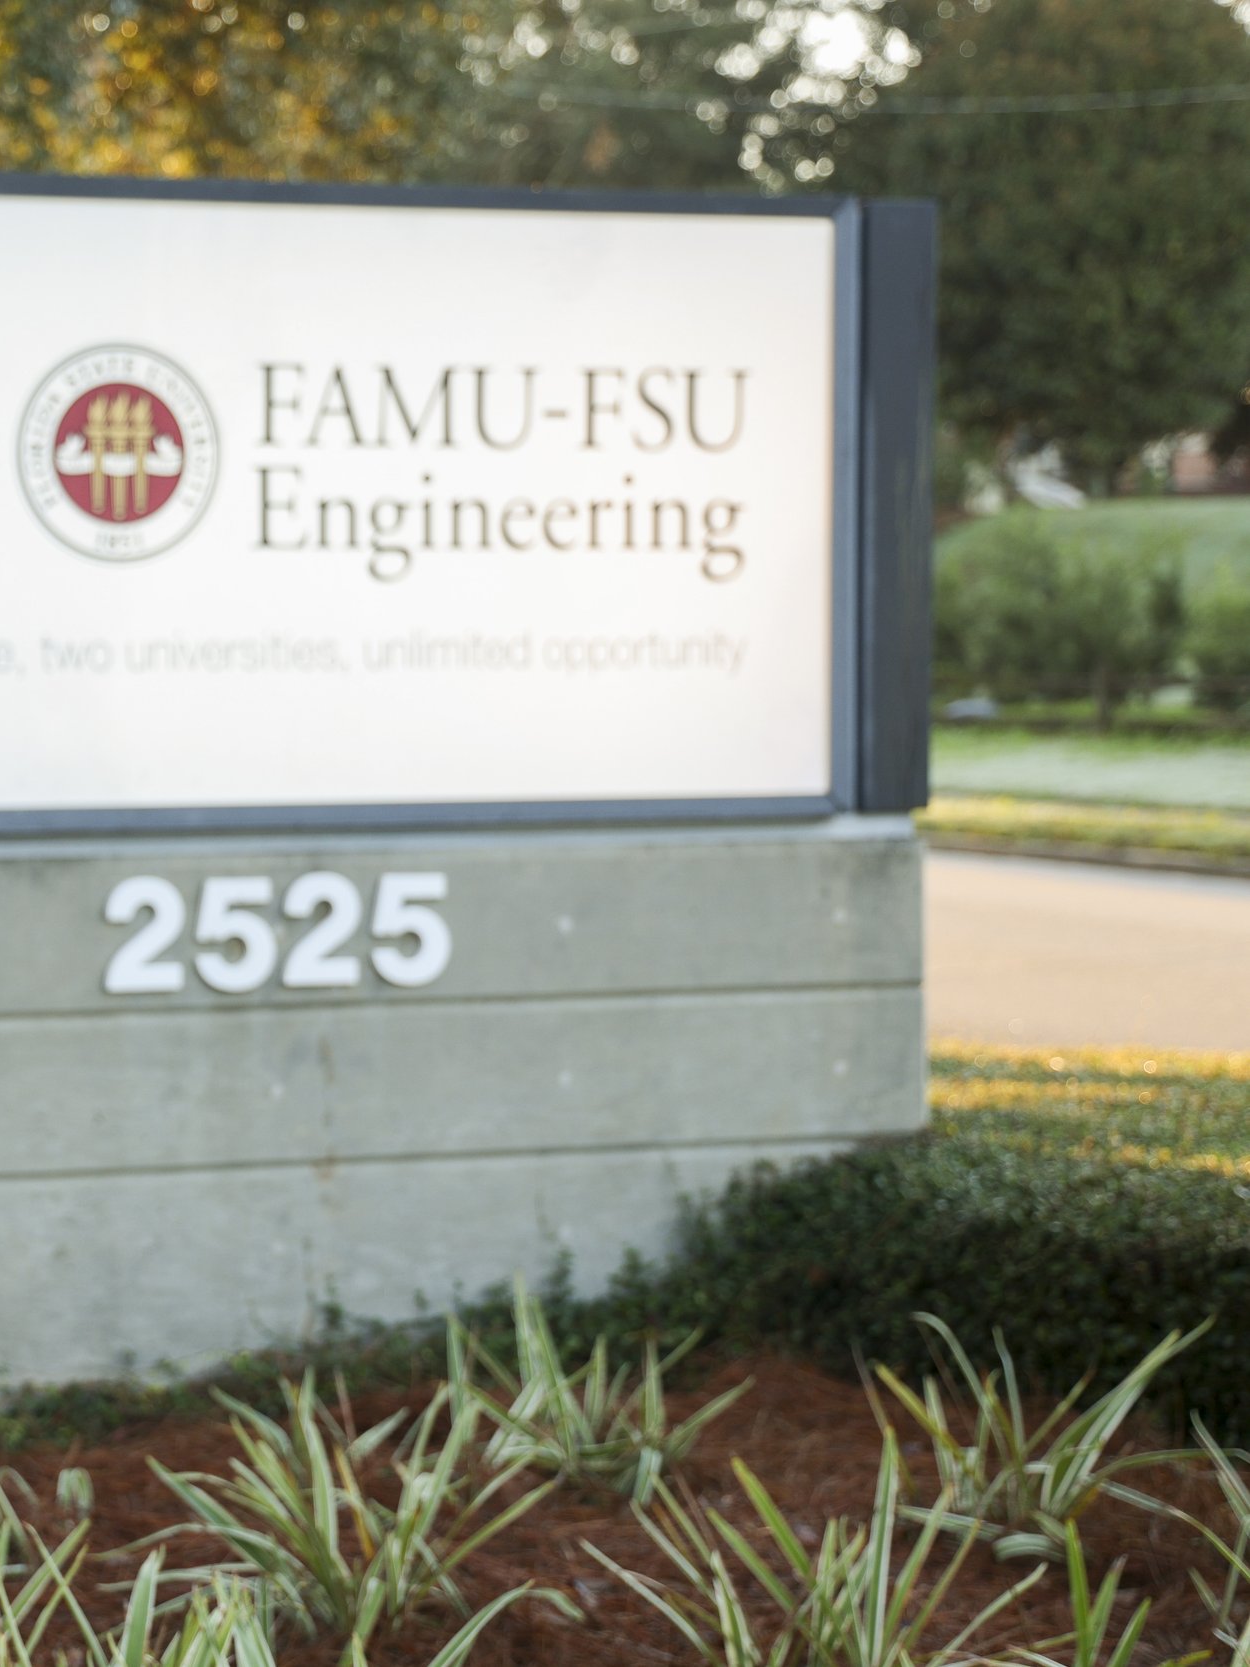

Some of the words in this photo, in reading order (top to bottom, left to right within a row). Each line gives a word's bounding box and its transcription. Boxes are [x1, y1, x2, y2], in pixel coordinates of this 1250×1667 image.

[256, 361, 751, 453] FAMU-FSU
[254, 465, 746, 584] Engineering
[40, 630, 114, 674] two
[124, 627, 350, 676] universities,
[361, 626, 532, 673] unlimited
[543, 628, 748, 679] opportunity
[104, 870, 452, 994] 2525
